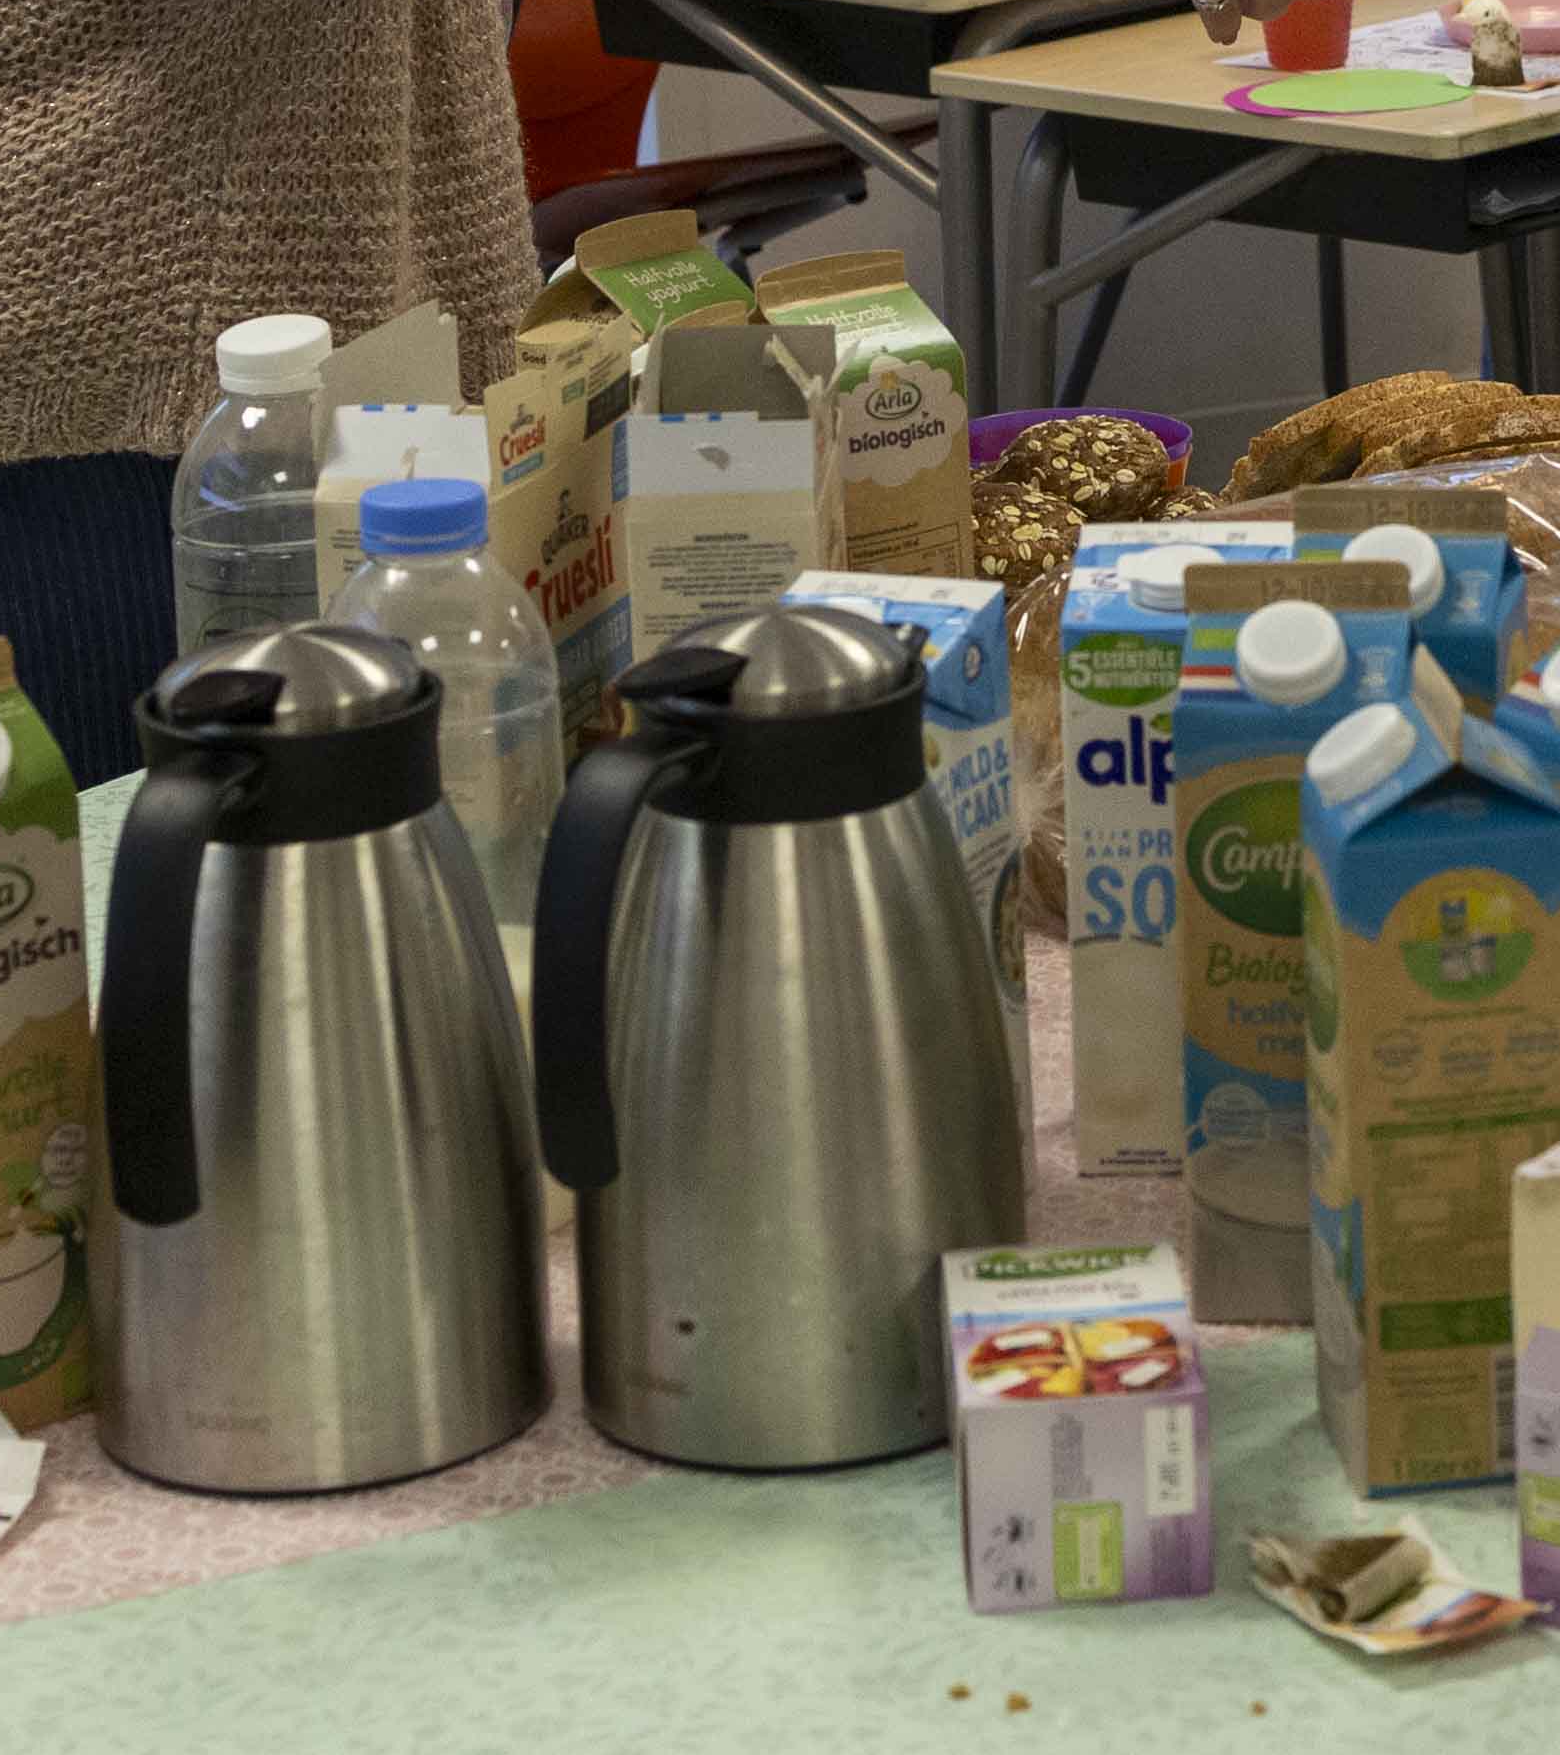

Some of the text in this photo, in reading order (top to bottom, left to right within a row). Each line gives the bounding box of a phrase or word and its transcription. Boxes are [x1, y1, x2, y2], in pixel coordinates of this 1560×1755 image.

[624, 260, 702, 288] Halfvolle
[647, 275, 716, 308] yoghurt
[873, 387, 913, 412] Arla
[848, 411, 946, 455] biologisch
[1067, 651, 1092, 688] 5
[1077, 715, 1175, 805] alp
[1138, 828, 1173, 857] PR
[1203, 825, 1304, 892] Camp
[1086, 864, 1176, 937] SO
[1207, 942, 1307, 996] Biolog
